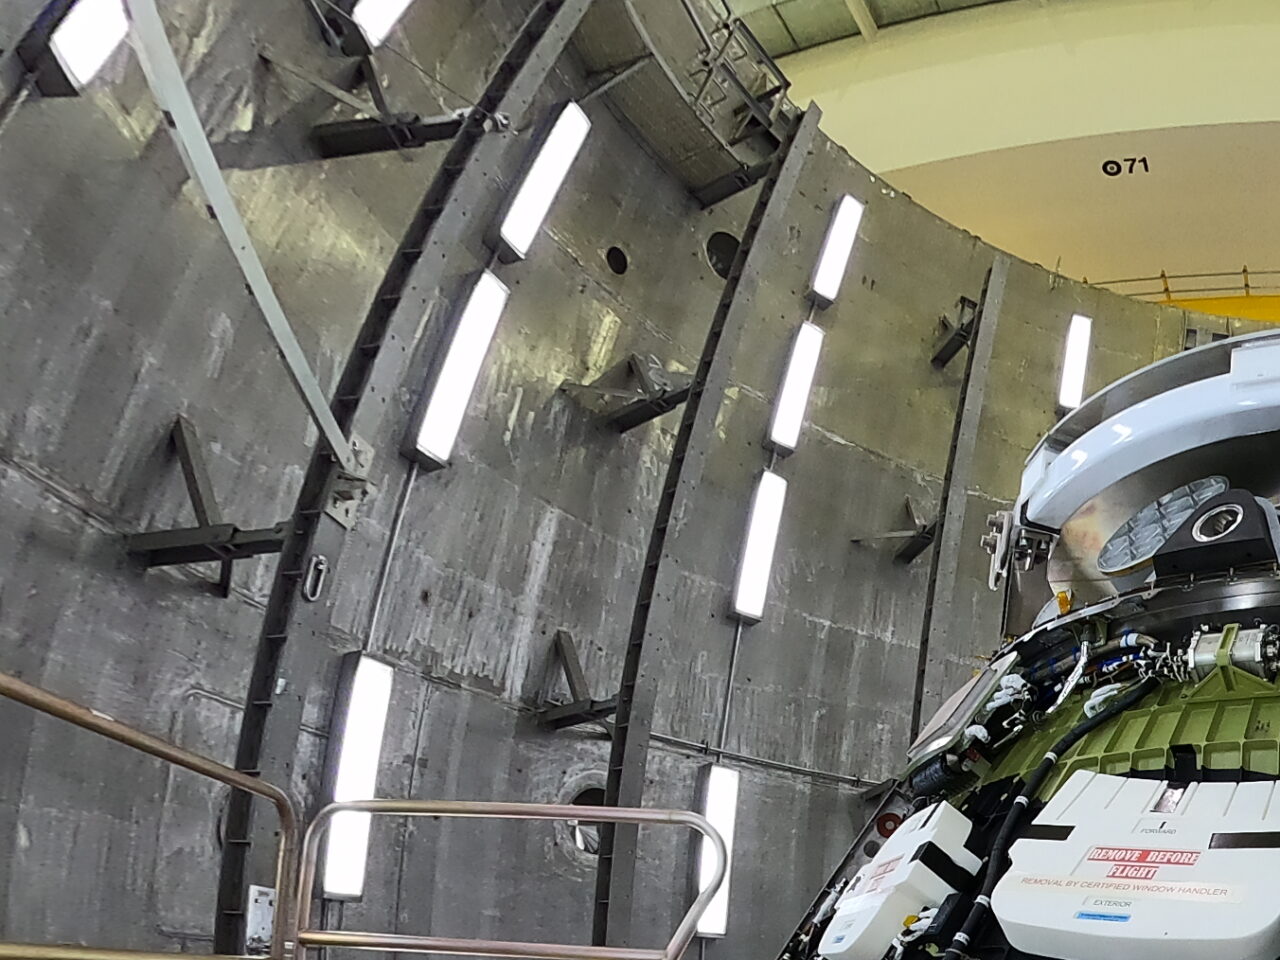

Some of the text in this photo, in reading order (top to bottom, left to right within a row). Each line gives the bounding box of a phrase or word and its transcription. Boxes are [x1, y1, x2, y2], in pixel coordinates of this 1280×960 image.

[1090, 849, 1200, 864] REMOVE BEFORE
[1108, 864, 1159, 879] FLIGHT
[1021, 877, 1063, 887] REMOVAL
[1080, 881, 1131, 891] CERTIFIED
[1132, 884, 1177, 893] WINDOW
[1177, 887, 1228, 896] HANDLER
[1093, 899, 1132, 907] EXTERIOR
